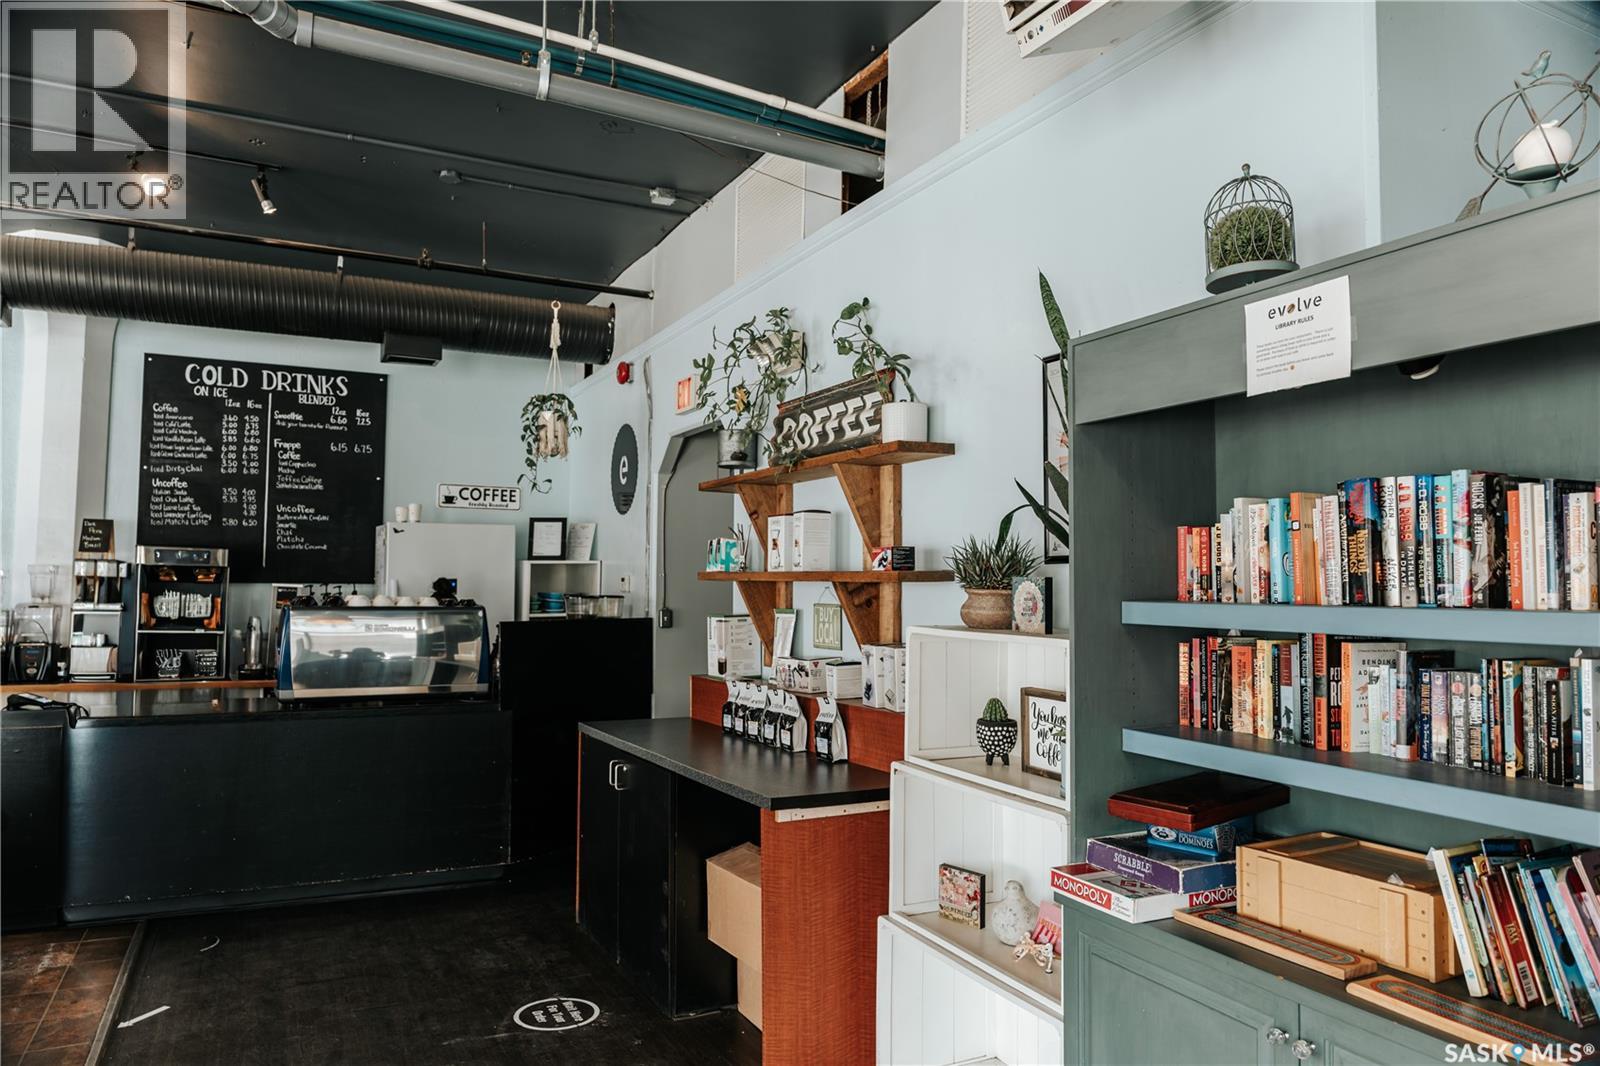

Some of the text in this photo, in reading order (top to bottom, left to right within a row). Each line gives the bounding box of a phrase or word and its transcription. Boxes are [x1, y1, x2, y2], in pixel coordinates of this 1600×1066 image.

[1275, 315, 1314, 330] LIBRARY RULES
[184, 363, 348, 396] COLD DRINKS
[193, 386, 228, 398] ON ICE
[153, 402, 179, 413] Coffee
[298, 394, 336, 406] BLENDED
[274, 410, 303, 421] Smoothie
[331, 407, 346, 416] 12oz
[777, 391, 882, 455] COFFEE
[274, 439, 372, 453] Frappe 6.15 6.75
[278, 450, 300, 460] Coffee
[166, 464, 185, 474] Dirty
[186, 464, 202, 472] Chai
[620, 455, 628, 486] e
[152, 477, 188, 488] Uncoffee
[459, 487, 516, 502] COFFEE
[276, 504, 315, 513] Uncoffee
[1419, 501, 1428, 530] ROBB
[1472, 481, 1484, 545] ROCKS JOE PERRY
[1348, 535, 1357, 573] THINGS
[1356, 529, 1368, 576] NEEDFUL
[820, 607, 833, 621] BUY
[816, 614, 838, 644] LOCAL
[1302, 687, 1310, 714] CAROLINA
[1031, 702, 1050, 730] You
[1179, 836, 1213, 849] DOMINOES
[1114, 853, 1152, 872] SCRABBLE
[1054, 875, 1108, 905] MONOPOLY
